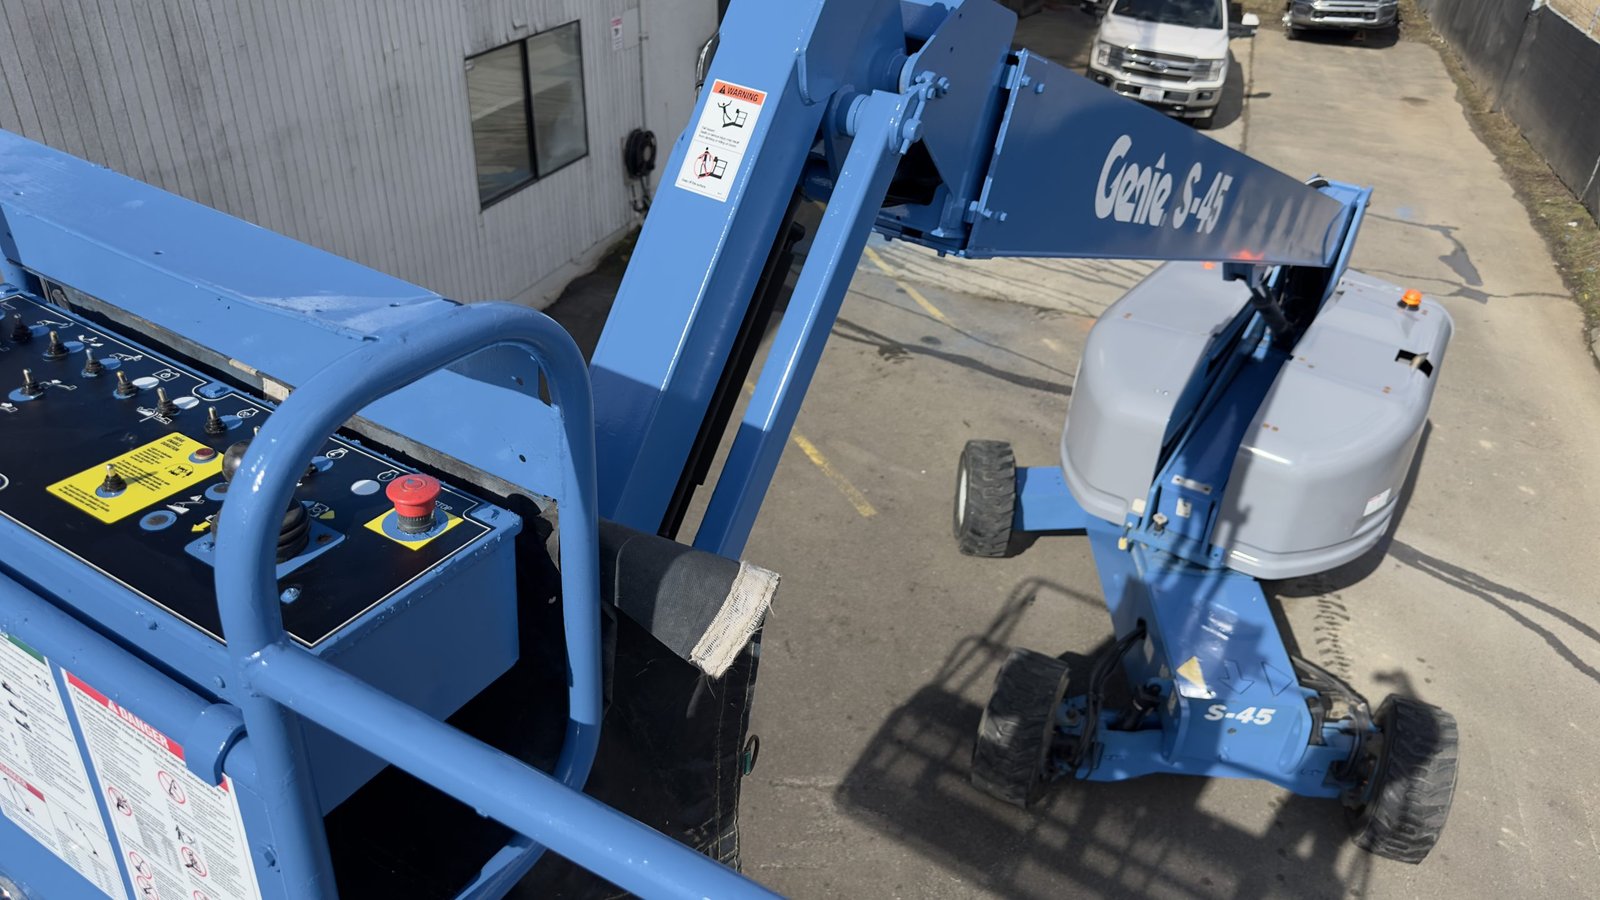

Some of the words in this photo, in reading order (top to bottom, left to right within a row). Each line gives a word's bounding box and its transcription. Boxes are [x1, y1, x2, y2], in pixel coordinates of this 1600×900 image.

[727, 87, 759, 102] WARNING
[1095, 134, 1173, 227] Genie
[1172, 161, 1234, 234] S-45
[435, 500, 453, 511] STOP
[1203, 704, 1277, 726] S-45
[118, 705, 170, 750] DANGER
